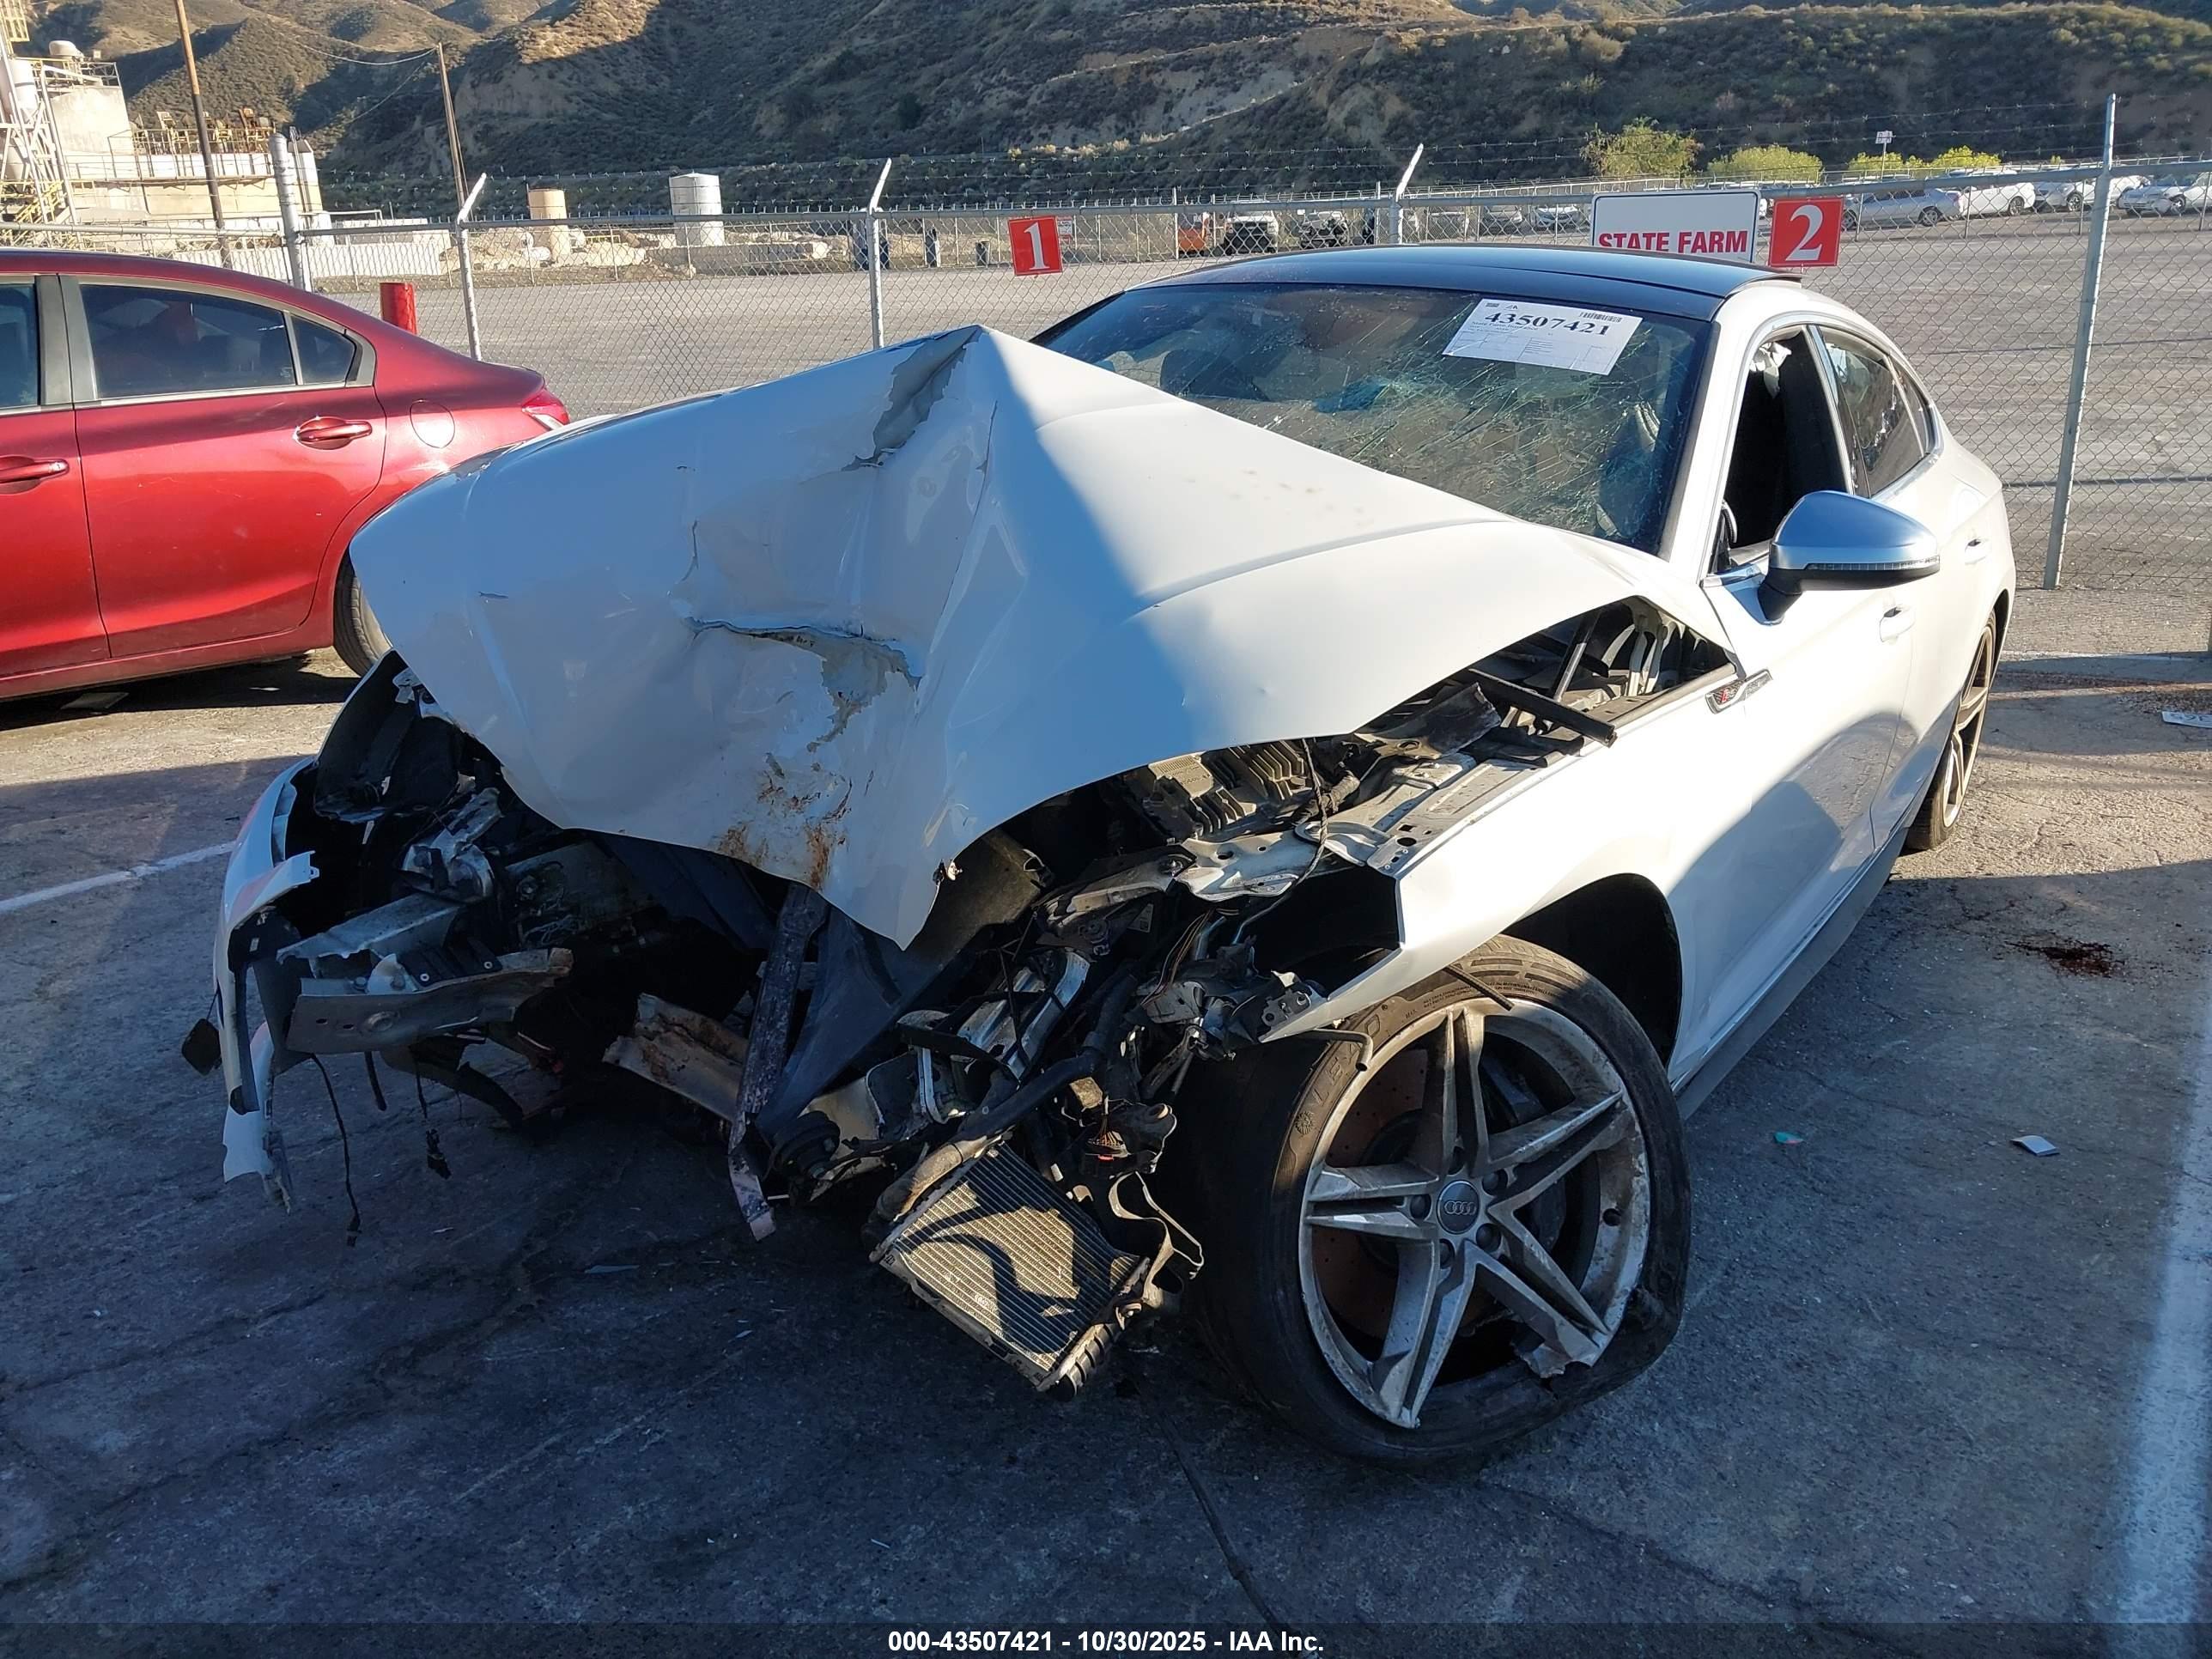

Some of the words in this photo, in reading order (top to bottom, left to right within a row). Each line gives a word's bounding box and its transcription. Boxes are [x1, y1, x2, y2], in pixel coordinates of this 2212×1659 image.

[1024, 221, 1050, 270] 1
[1598, 232, 1670, 252] STATE
[1677, 230, 1748, 254] FARM
[1785, 204, 1824, 261] 2
[1485, 311, 1609, 336] 43507421
